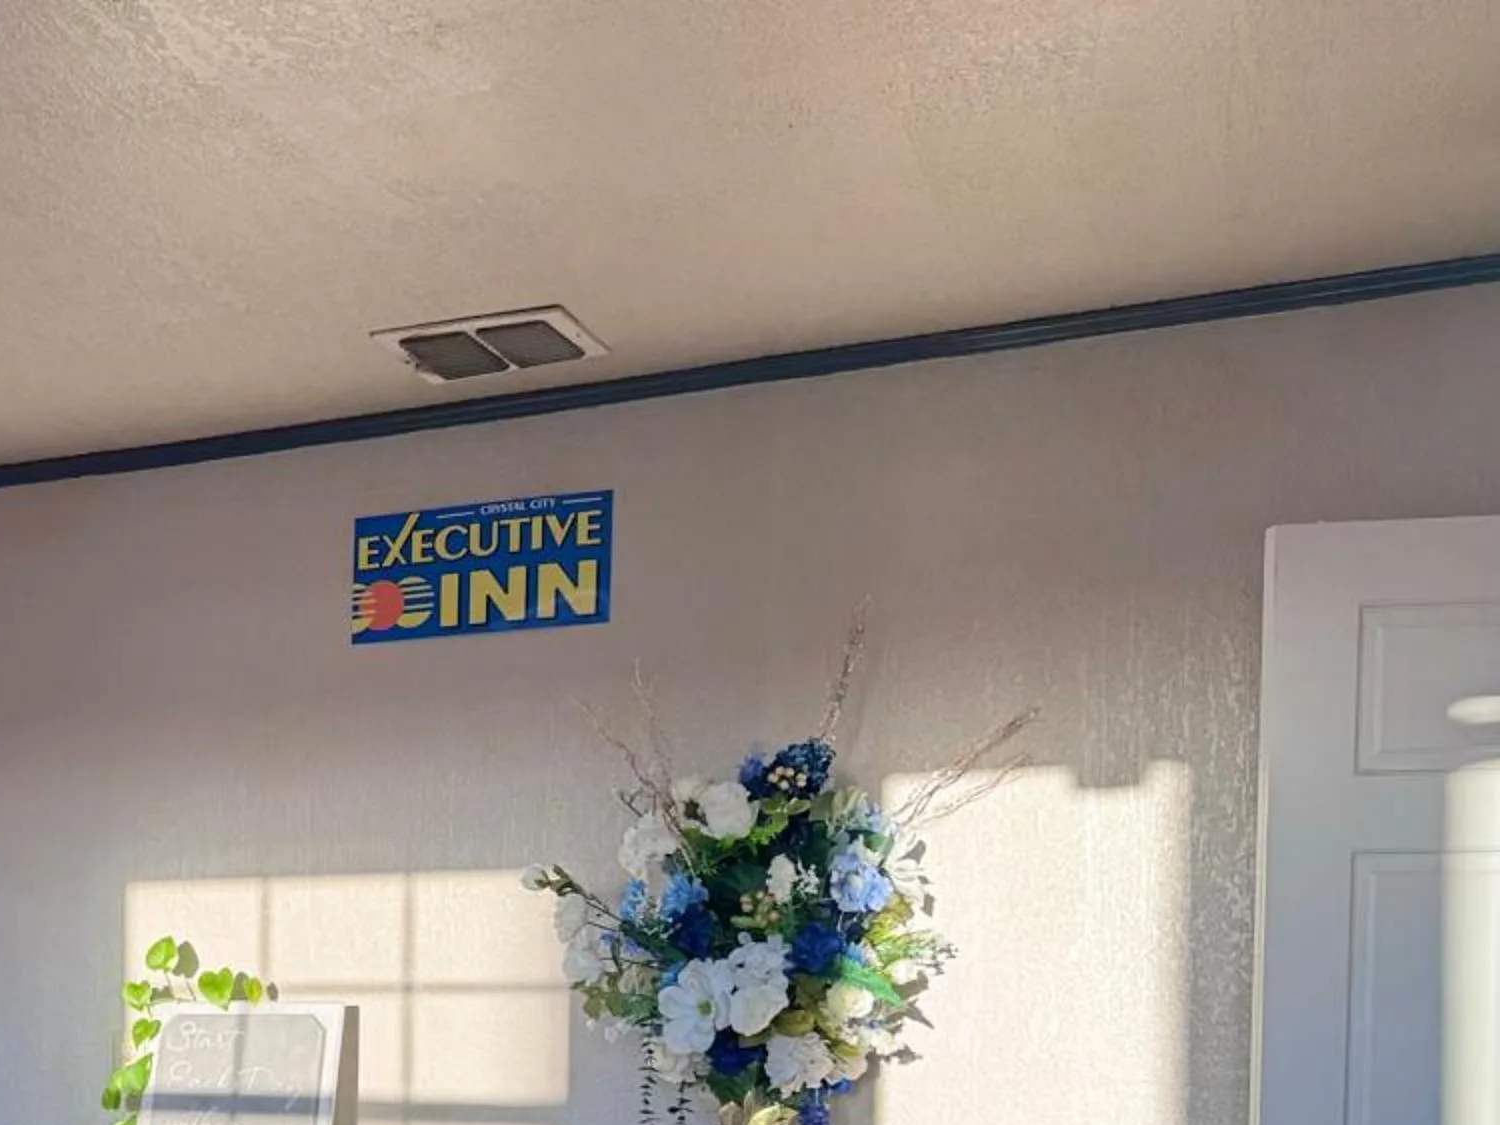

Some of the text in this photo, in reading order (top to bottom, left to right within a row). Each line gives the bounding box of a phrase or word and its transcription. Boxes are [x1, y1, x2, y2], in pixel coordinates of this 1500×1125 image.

[480, 498, 557, 515] CRYSTAL CITY
[356, 510, 603, 571] EXECUTIVE
[439, 558, 598, 628] INN
